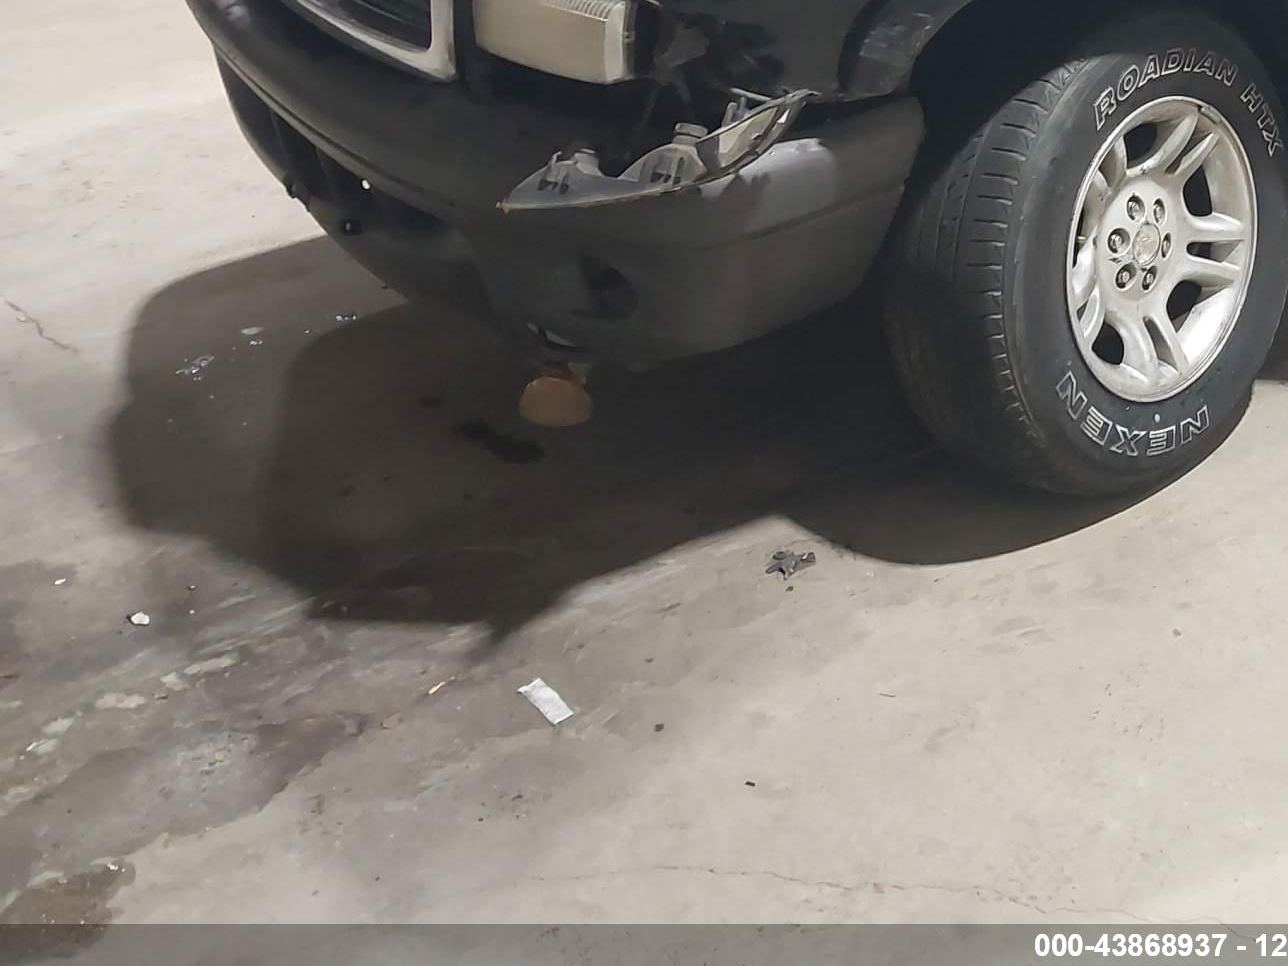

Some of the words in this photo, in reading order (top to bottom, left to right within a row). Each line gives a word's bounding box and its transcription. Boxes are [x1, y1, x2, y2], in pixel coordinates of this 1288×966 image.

[1093, 48, 1239, 131] ROADIAN
[1240, 82, 1284, 158] HTX
[1056, 370, 1210, 457] NEXEN
